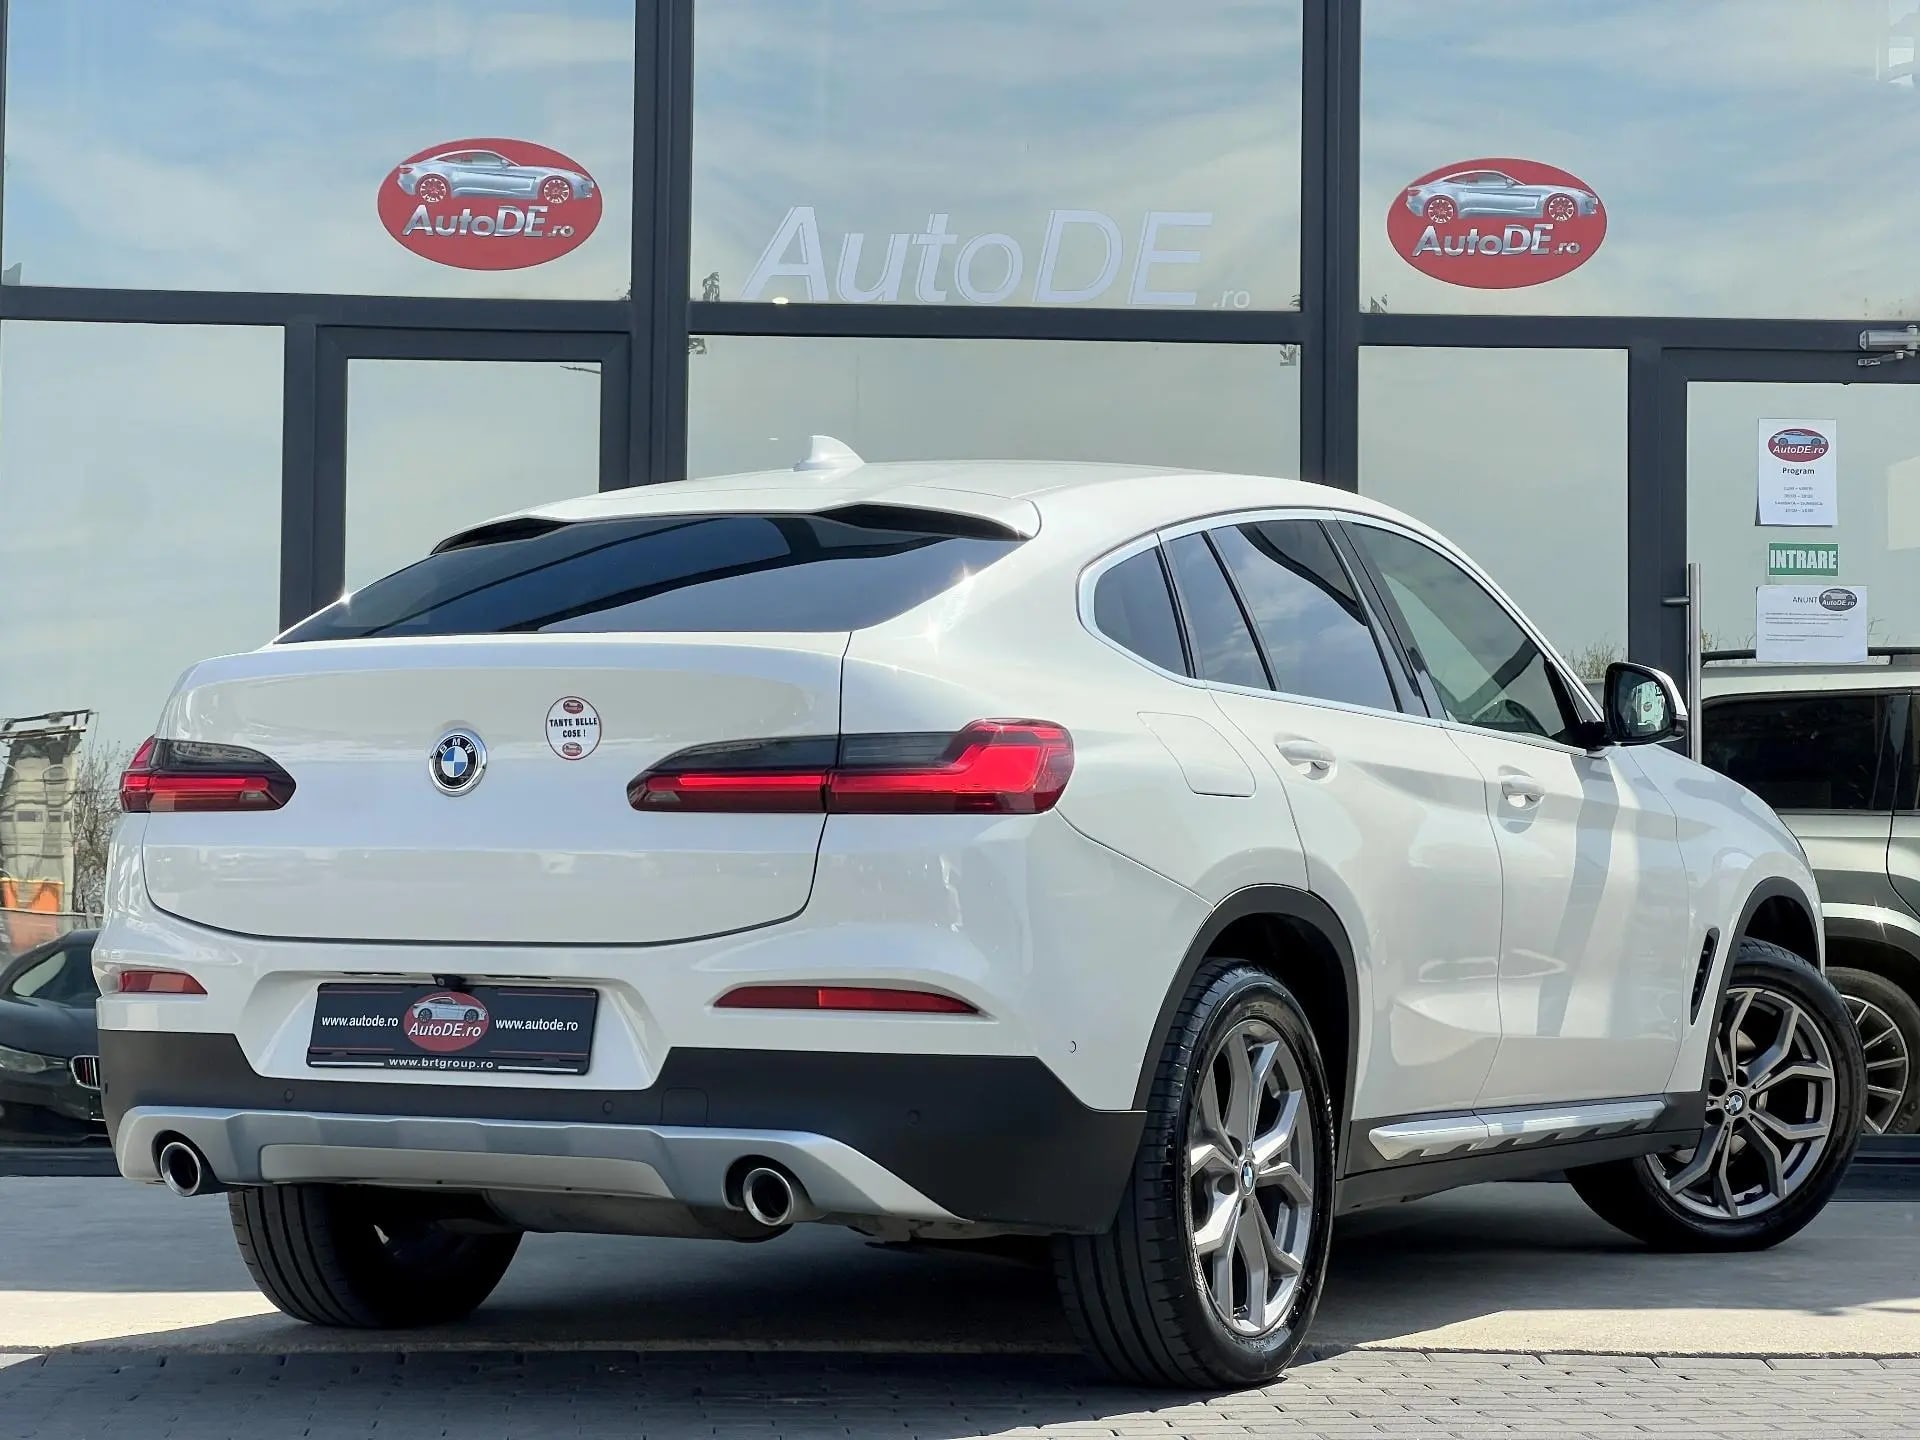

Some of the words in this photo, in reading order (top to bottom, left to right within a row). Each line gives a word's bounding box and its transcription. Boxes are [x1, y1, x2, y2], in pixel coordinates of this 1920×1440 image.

[1773, 445, 1825, 454] AutoDE.ro
[1782, 467, 1815, 475] Program
[1770, 550, 1837, 569] INTRARE
[549, 718, 573, 727] TANTE
[575, 717, 598, 726] BELLE
[562, 729, 581, 738] COSE
[321, 1014, 399, 1027] www.autode.ro
[495, 1019, 578, 1032] www.autode.ro
[408, 1022, 482, 1038] AutoDE.ro
[389, 1057, 494, 1070] www.brtgroup.ro
